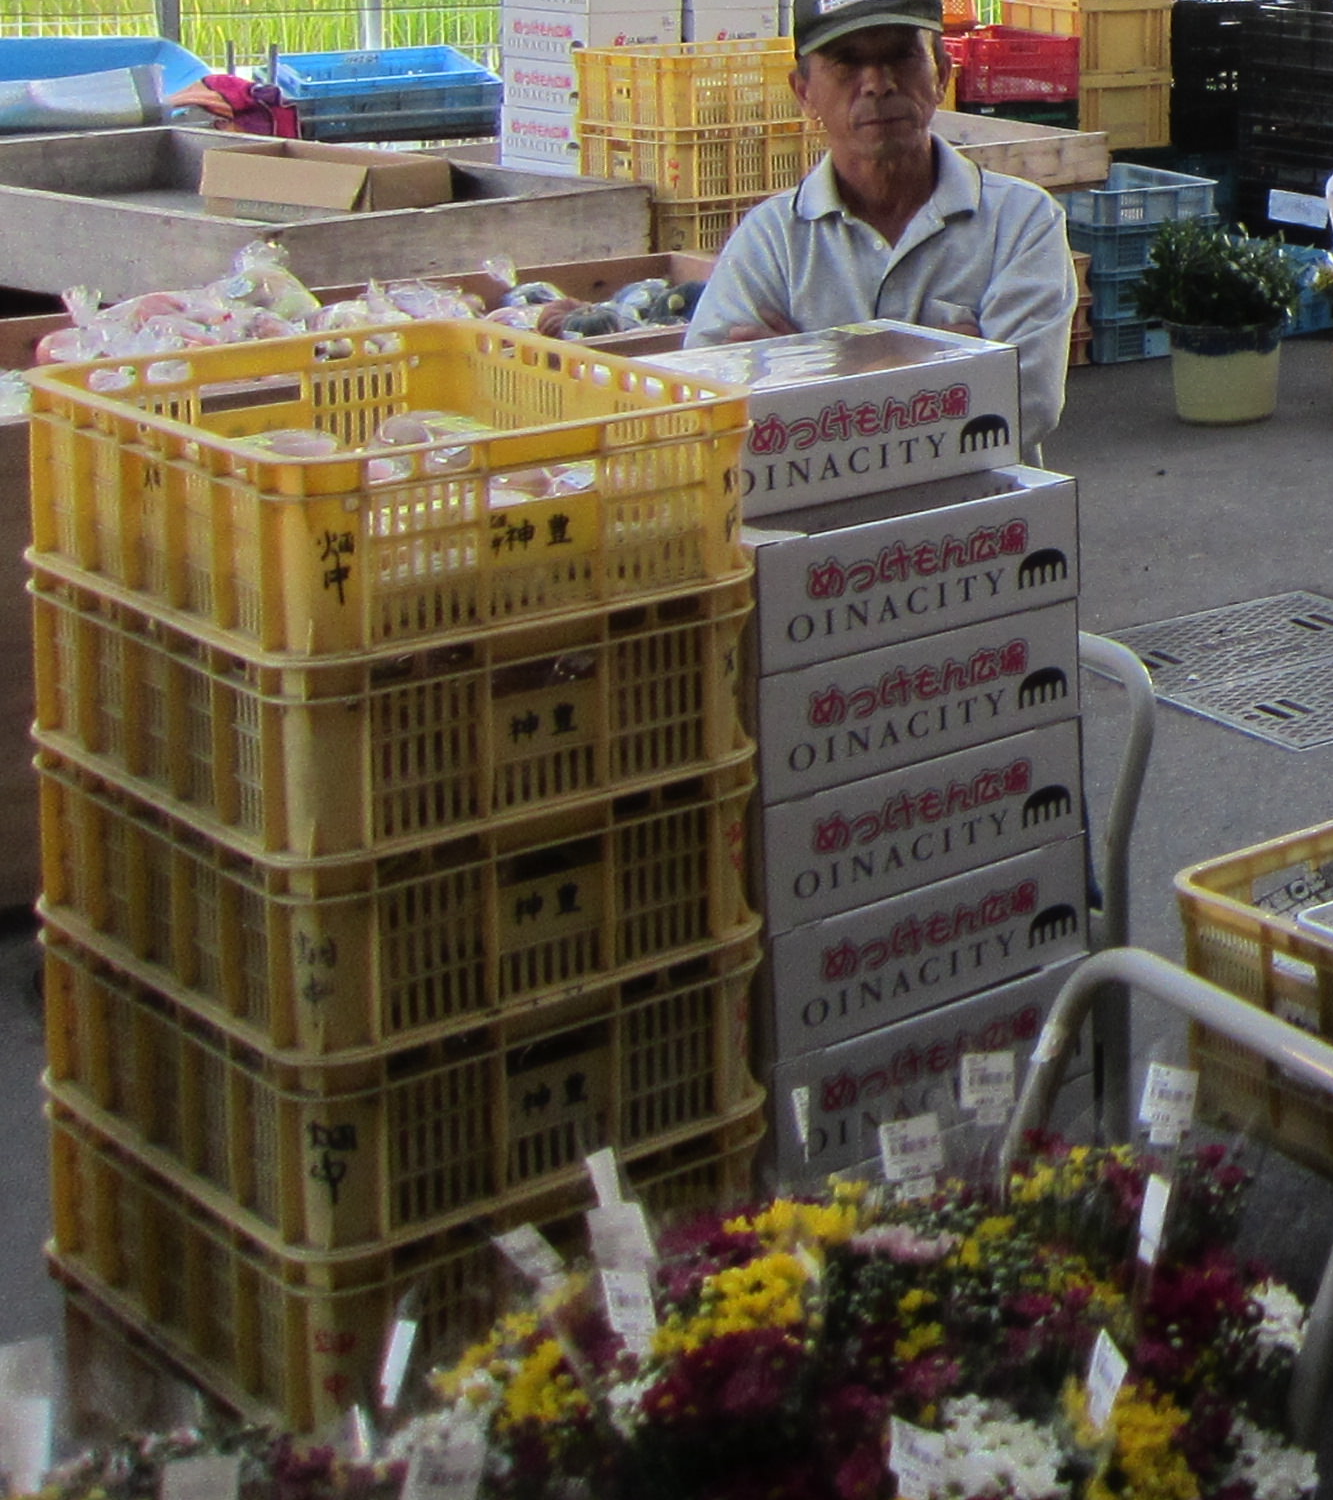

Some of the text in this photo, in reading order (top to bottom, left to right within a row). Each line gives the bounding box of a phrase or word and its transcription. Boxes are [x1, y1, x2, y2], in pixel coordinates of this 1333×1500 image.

[509, 37, 567, 54] OINACITY
[751, 383, 970, 455] めっけもん広場
[808, 518, 1028, 599] めっけもん広場
[787, 567, 1006, 644] OINACITY
[809, 638, 1029, 727] めっけもん広場
[788, 689, 1006, 772] OINACITY
[814, 757, 1032, 854] めっけもん広場
[793, 809, 1009, 898] OINACITY
[822, 879, 1039, 981] めっけもん広場
[801, 929, 1015, 1028] OINACITY
